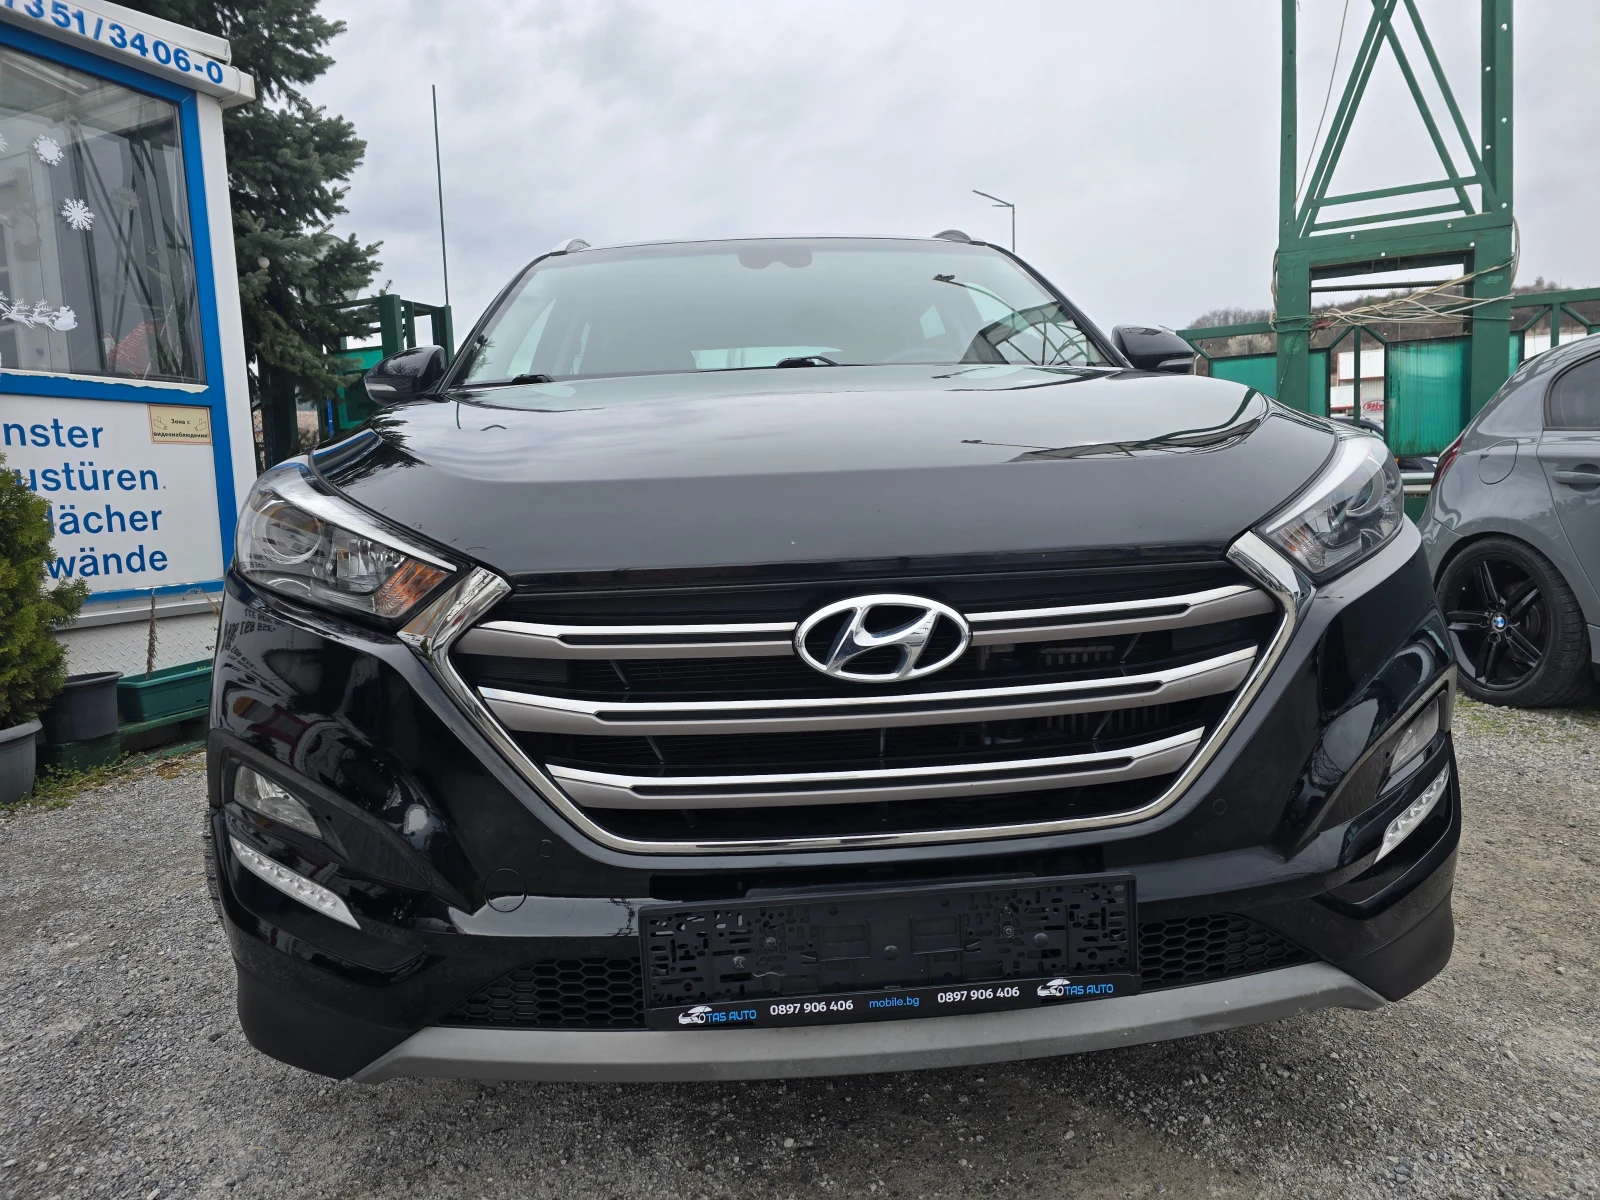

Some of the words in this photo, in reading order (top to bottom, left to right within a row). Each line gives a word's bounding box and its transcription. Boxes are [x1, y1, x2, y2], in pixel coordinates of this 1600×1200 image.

[705, 1011, 727, 1023] TAS
[728, 1009, 757, 1021] AUTO
[769, 1003, 800, 1016] 0897
[803, 1001, 826, 1013] 906
[829, 999, 854, 1011] 406
[868, 996, 920, 1009] mobile.bg
[937, 991, 967, 1003] 0897
[970, 989, 994, 1000] 906
[996, 986, 1020, 998] 406
[1064, 985, 1085, 996] TAS
[1086, 983, 1114, 994] AUTO
